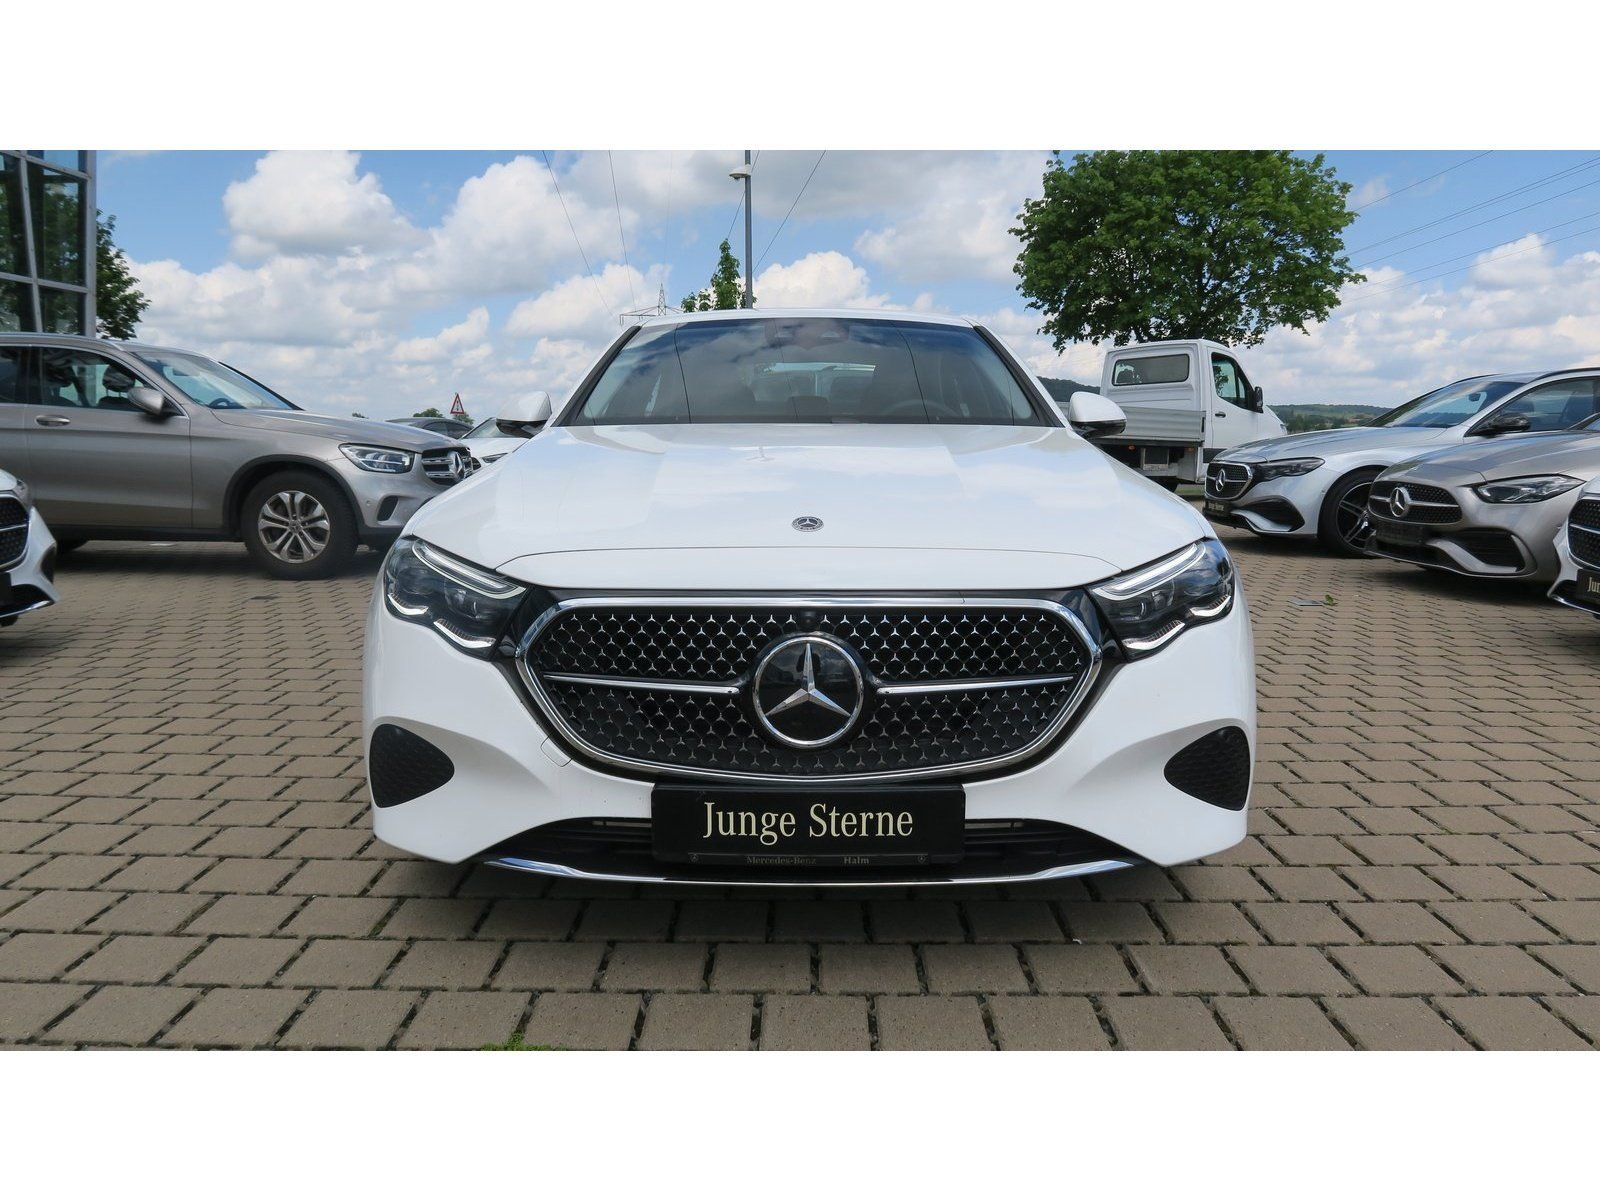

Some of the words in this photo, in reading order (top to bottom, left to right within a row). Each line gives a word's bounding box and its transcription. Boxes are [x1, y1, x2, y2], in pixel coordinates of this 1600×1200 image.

[703, 802, 796, 845] Junge
[809, 803, 913, 837] Sterne
[746, 856, 816, 865] Mercedes-Benz
[843, 856, 870, 865] Halm
